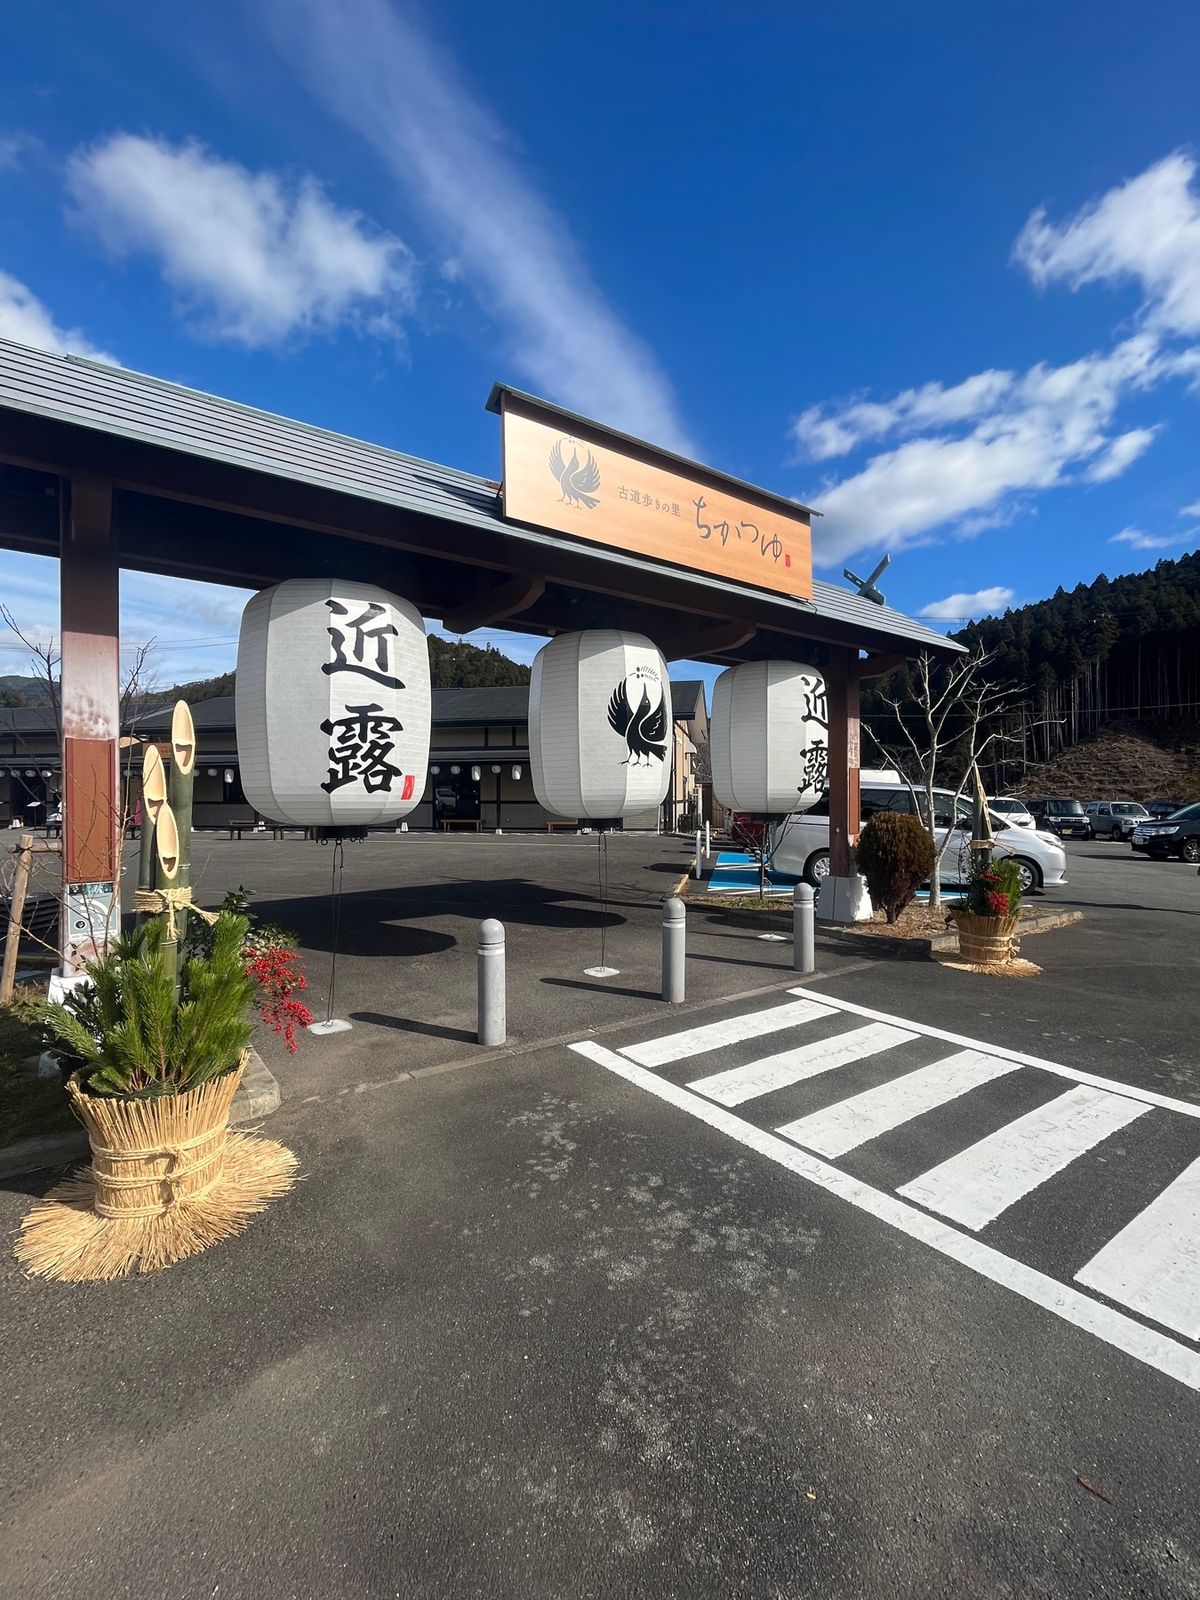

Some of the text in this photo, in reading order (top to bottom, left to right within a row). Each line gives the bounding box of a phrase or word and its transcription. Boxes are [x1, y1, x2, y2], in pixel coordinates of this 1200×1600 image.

[617, 485, 681, 517] 古道歩きの里
[692, 496, 783, 562] ちかつゆ
[320, 599, 406, 794] 近露
